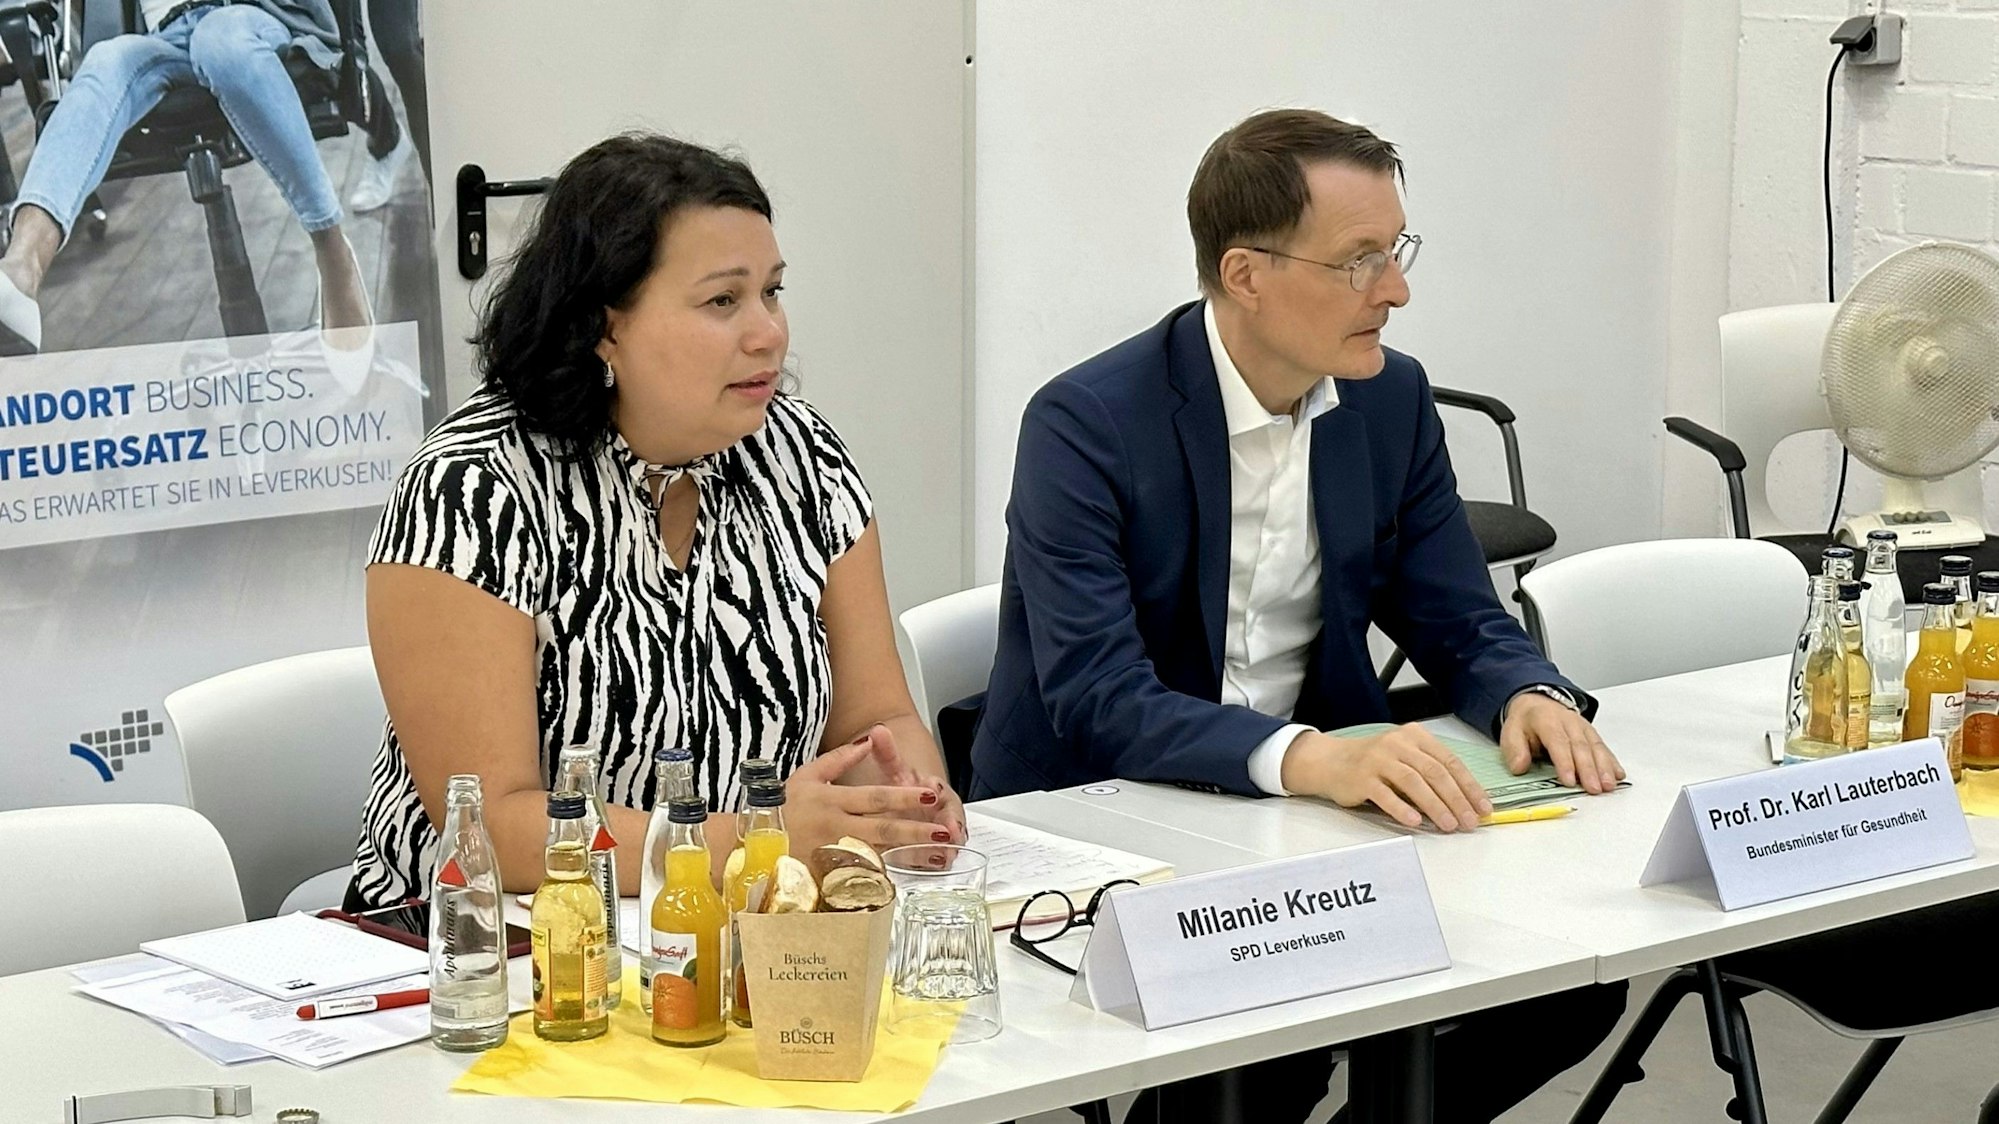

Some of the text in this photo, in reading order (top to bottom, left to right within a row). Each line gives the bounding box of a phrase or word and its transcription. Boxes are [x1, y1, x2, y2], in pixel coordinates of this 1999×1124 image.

[146, 368, 314, 413] BUSINESS.
[218, 410, 392, 458] ECONOMY.
[34, 484, 160, 521] ERWARTET
[167, 478, 201, 505] SIE
[209, 476, 231, 499] IN
[238, 459, 393, 497] LEVERKUSEN!
[1708, 763, 1941, 831] Prof. Dr. Karl Lauterbach
[1746, 808, 1928, 860] Bundesminister für Gesundheit
[1176, 879, 1377, 940] Milanie Kreutz
[784, 952, 827, 966] Büschs
[1230, 928, 1346, 963] SPD Leverkusen
[769, 966, 848, 981] Leckereien
[780, 1028, 835, 1045] BÜSCH
